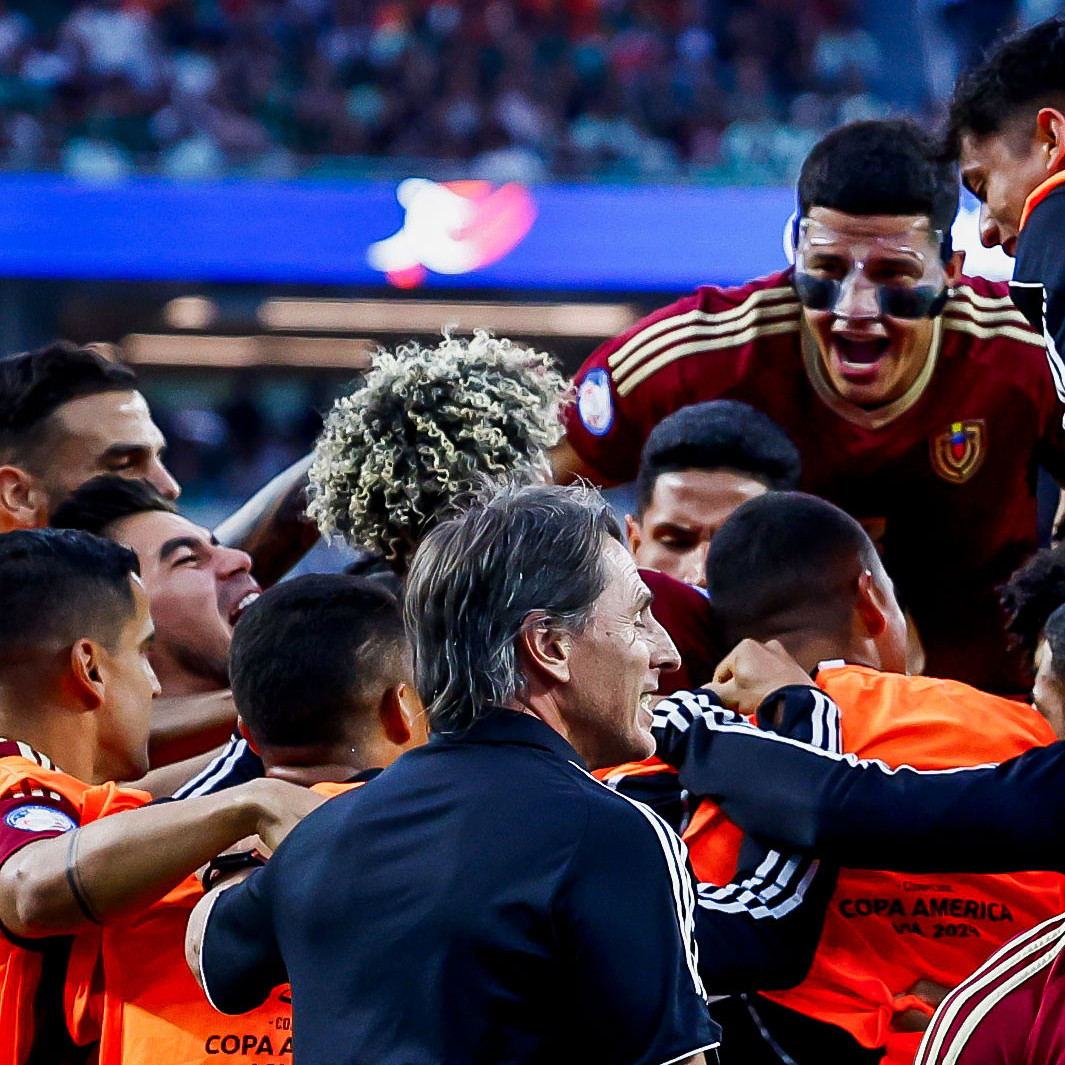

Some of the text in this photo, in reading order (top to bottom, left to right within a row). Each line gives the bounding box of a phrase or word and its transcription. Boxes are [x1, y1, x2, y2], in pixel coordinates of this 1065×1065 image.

[839, 897, 1014, 922] COPA AMERICA
[205, 1034, 274, 1056] COPA
